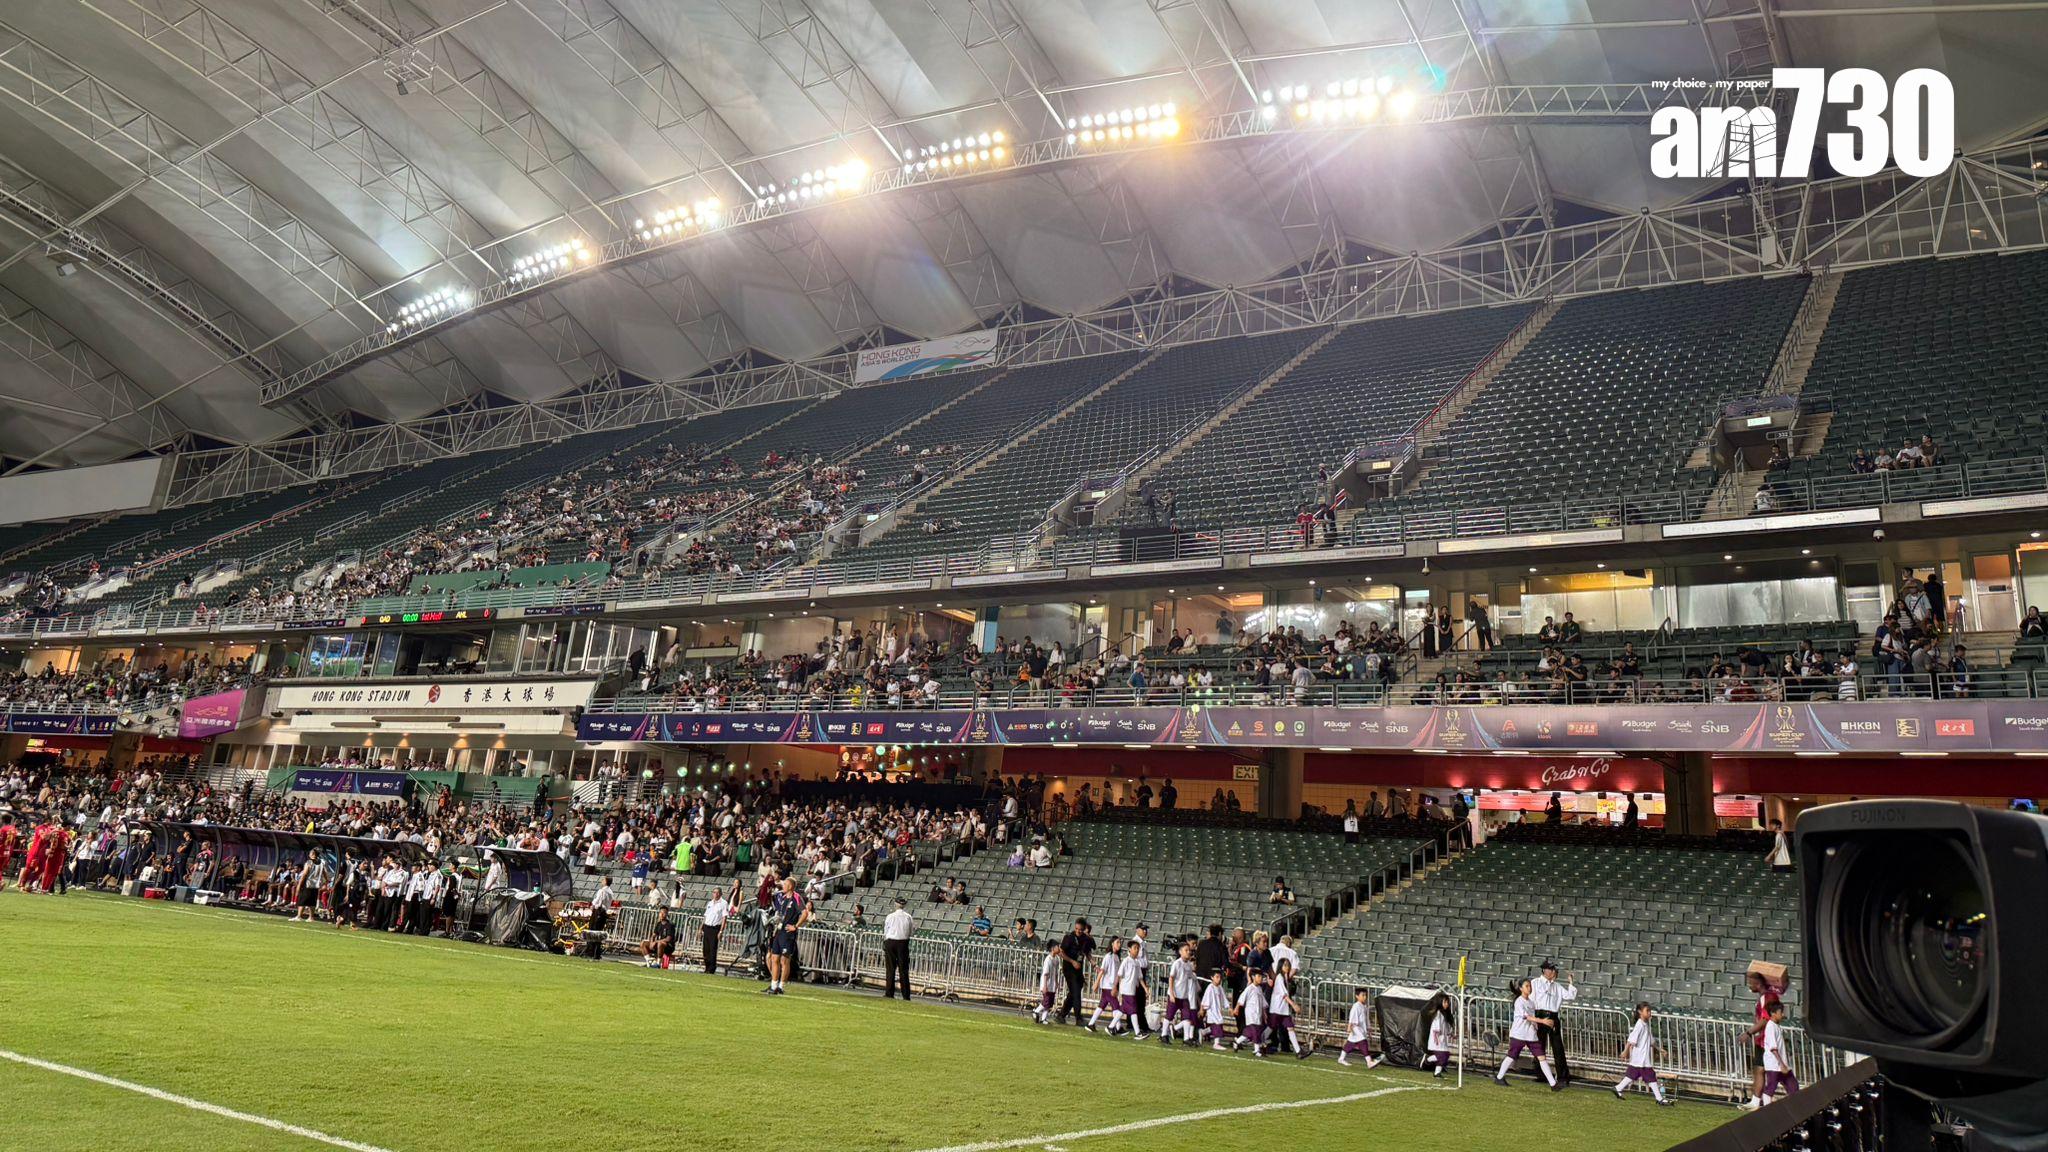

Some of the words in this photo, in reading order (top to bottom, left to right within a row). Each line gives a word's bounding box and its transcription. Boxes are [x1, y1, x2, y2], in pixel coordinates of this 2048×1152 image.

[862, 350, 890, 362] HONG
[892, 345, 921, 357] KONG
[882, 355, 904, 364] WORLD
[905, 353, 920, 361] CITY
[402, 613, 418, 622] 00:00
[312, 690, 335, 702] HONG
[339, 690, 364, 702] KONG
[367, 690, 411, 702] STADIUM
[463, 686, 555, 703] 香港大球場
[1331, 721, 1351, 729] Budget
[1632, 720, 1657, 729] Budget
[1701, 724, 1730, 733] SNB
[1849, 721, 1880, 730] HKBN
[1542, 764, 1576, 786] Grab
[1590, 758, 1610, 777] Go
[1850, 808, 1906, 823] FUJINON
